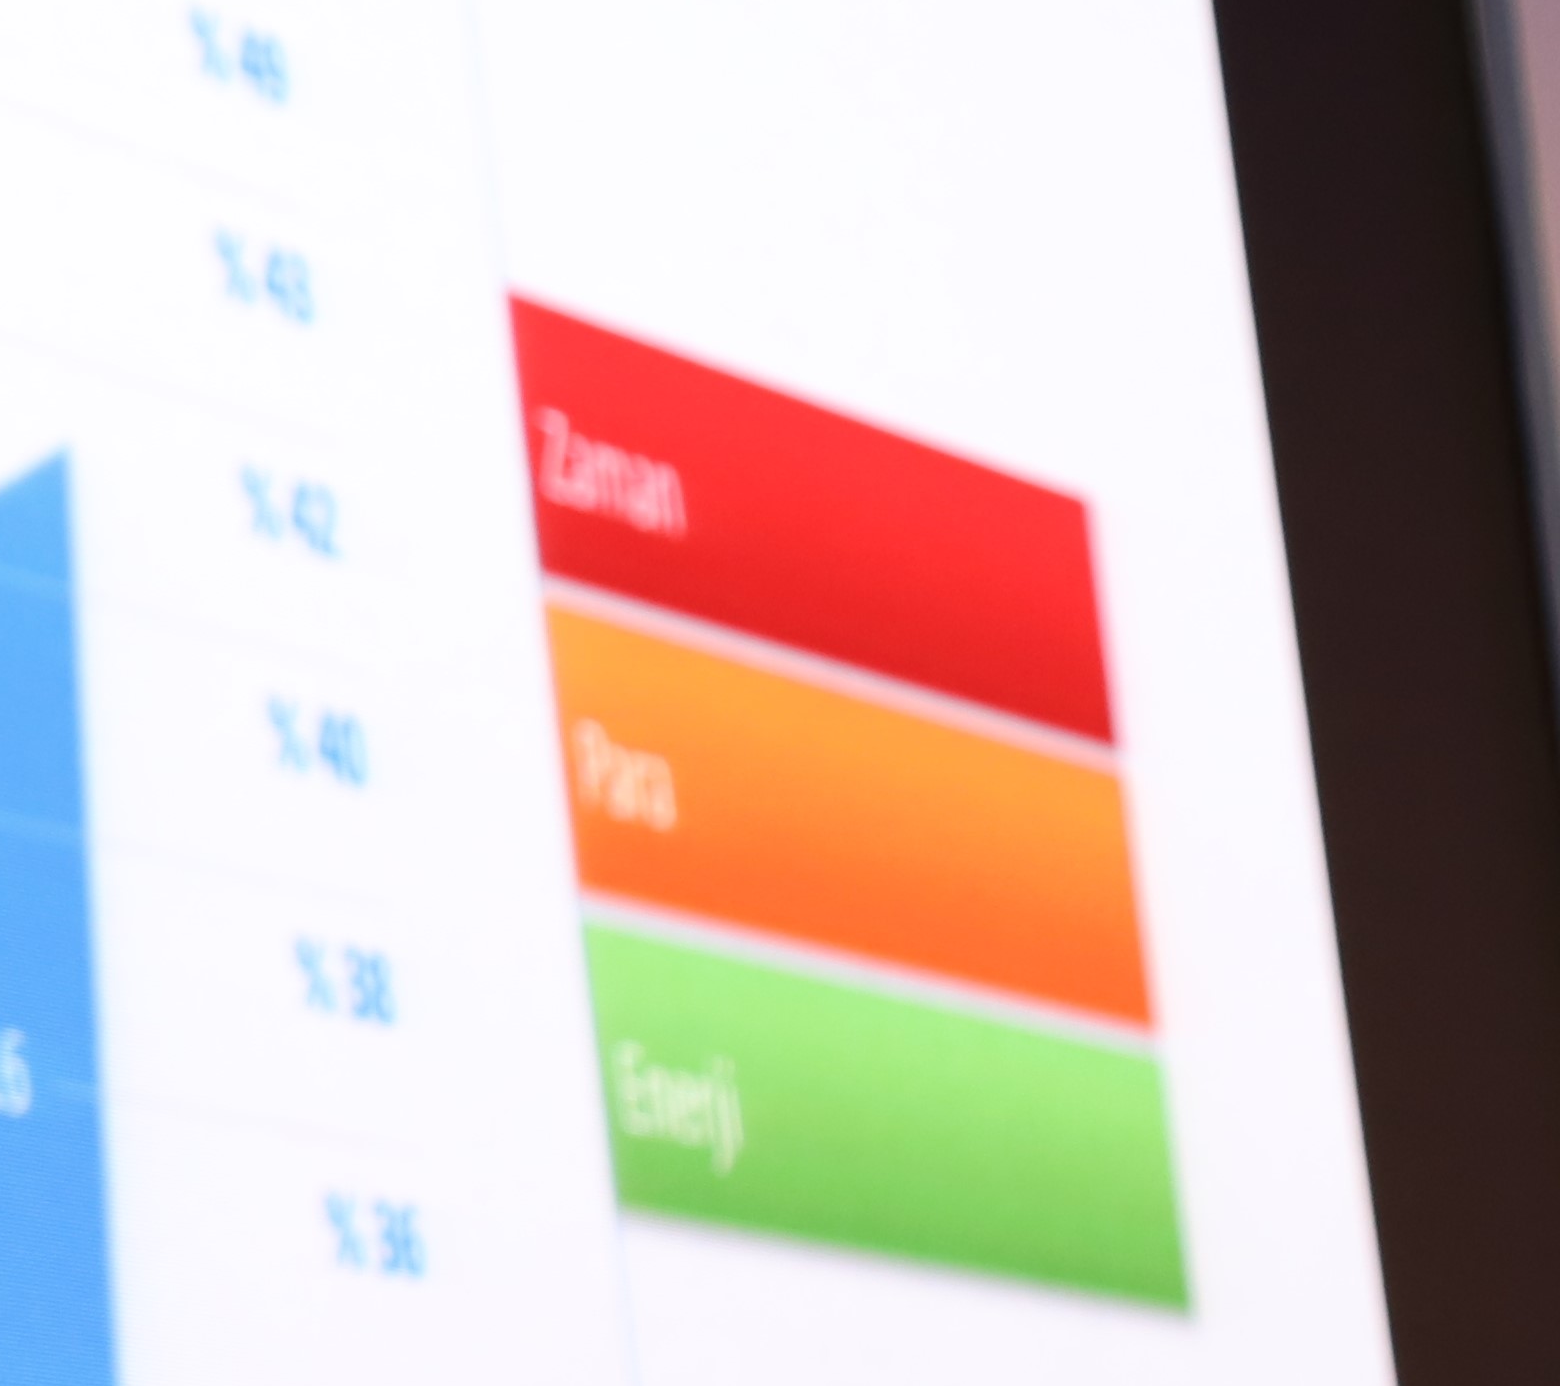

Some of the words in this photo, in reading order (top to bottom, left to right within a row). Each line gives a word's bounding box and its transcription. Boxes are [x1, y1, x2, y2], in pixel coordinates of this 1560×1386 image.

[535, 406, 686, 539] Zaman
[574, 716, 678, 833] Para
[614, 1040, 745, 1177] Enerji
